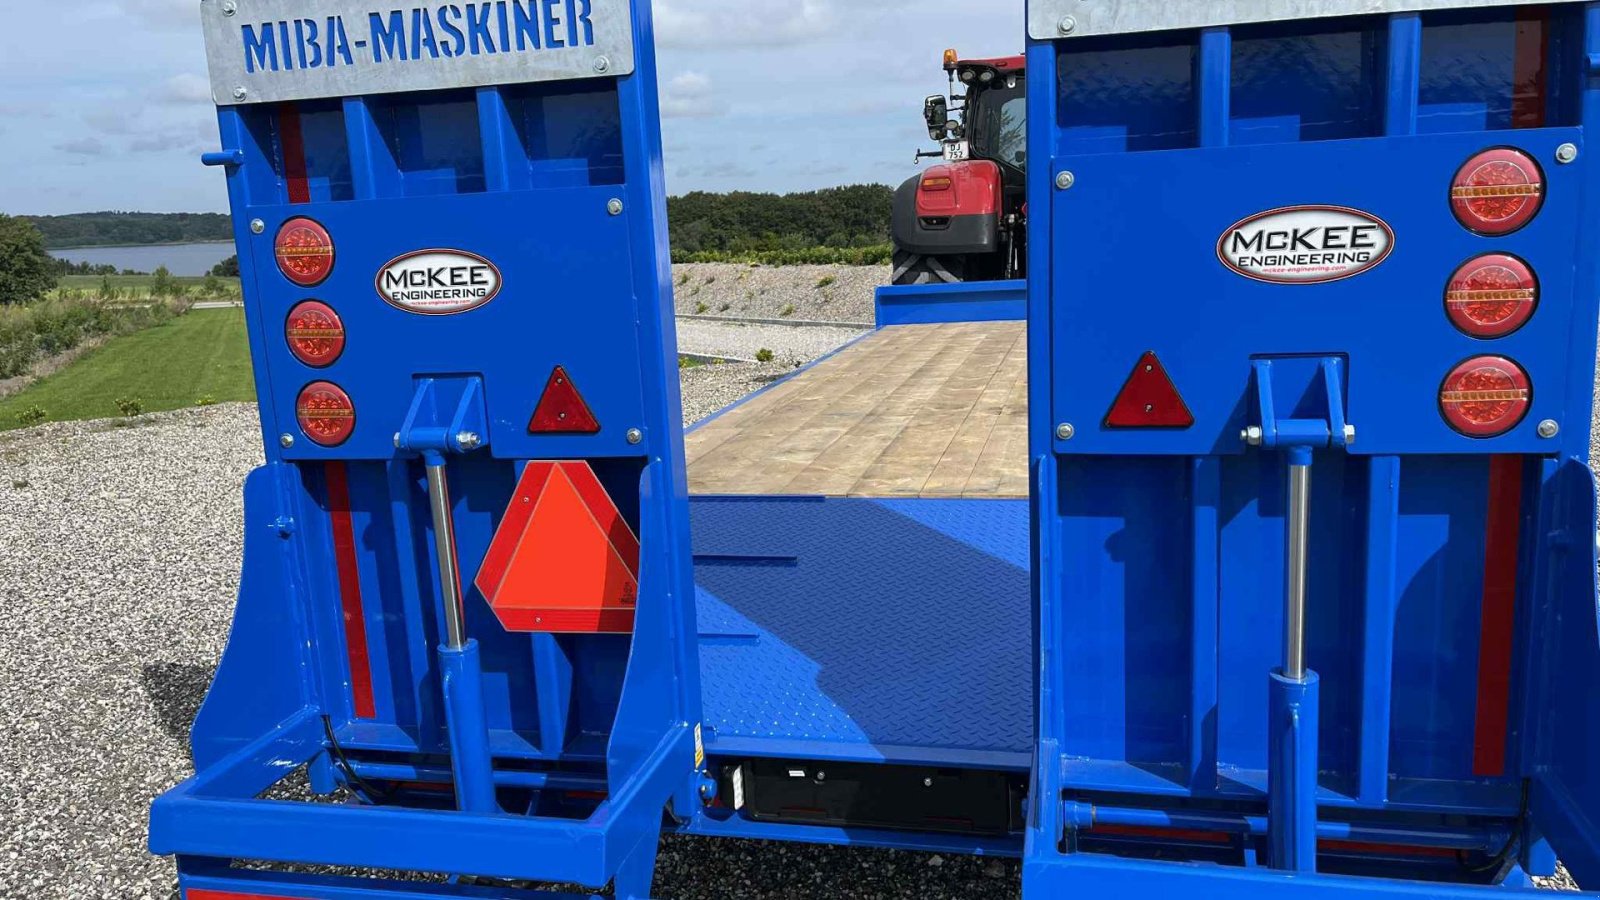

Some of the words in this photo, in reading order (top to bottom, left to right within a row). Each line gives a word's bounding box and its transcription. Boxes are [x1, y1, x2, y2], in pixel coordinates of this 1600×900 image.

[241, 0, 594, 73] MIBA-MASKINER
[949, 151, 963, 159] 752
[1237, 251, 1371, 267] ENGINEERING
[1262, 264, 1347, 275] mckee-engineering.com
[392, 287, 486, 301] ENGINEERING
